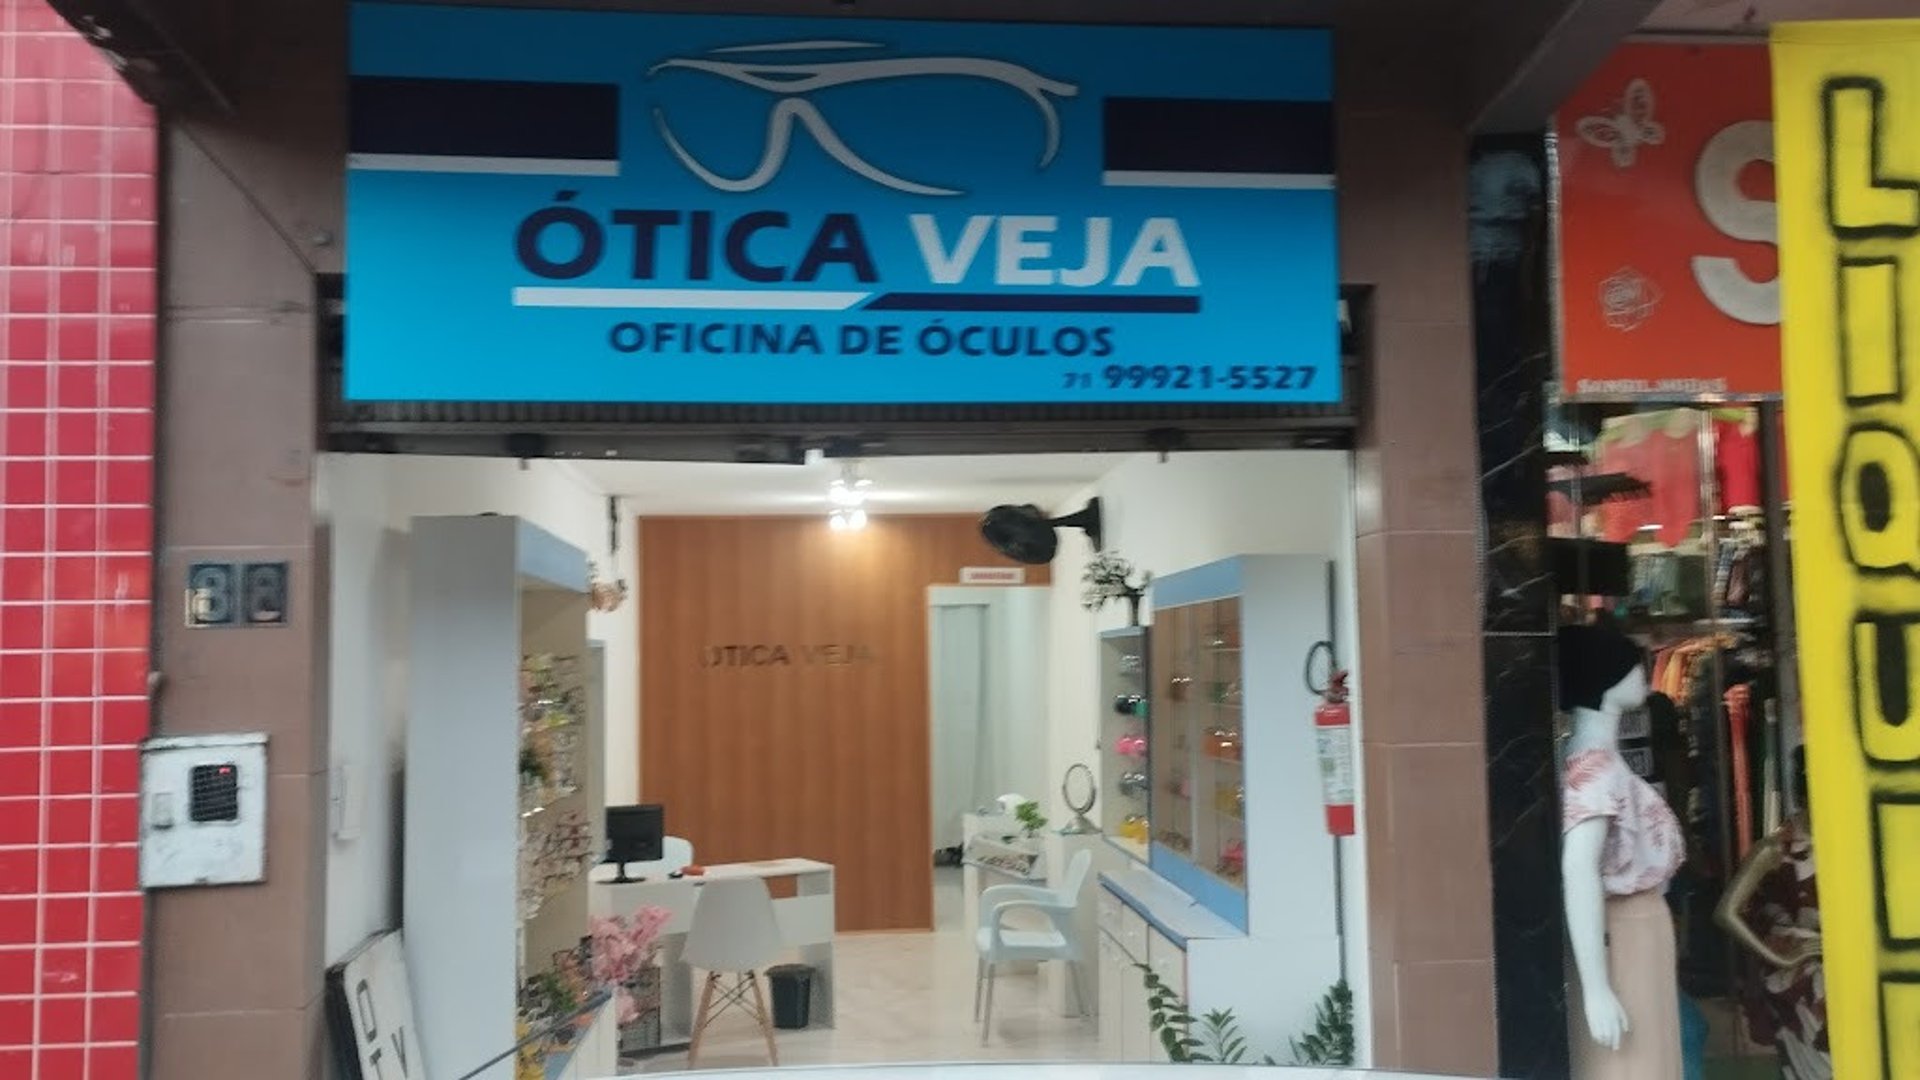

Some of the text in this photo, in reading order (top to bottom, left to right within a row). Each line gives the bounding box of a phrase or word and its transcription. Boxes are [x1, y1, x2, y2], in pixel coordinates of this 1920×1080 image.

[514, 190, 1201, 288] ÓTICA VEJA
[609, 318, 1115, 357] OFICINA DE ÓCULOS
[1062, 363, 1317, 390] 71 99921-5527
